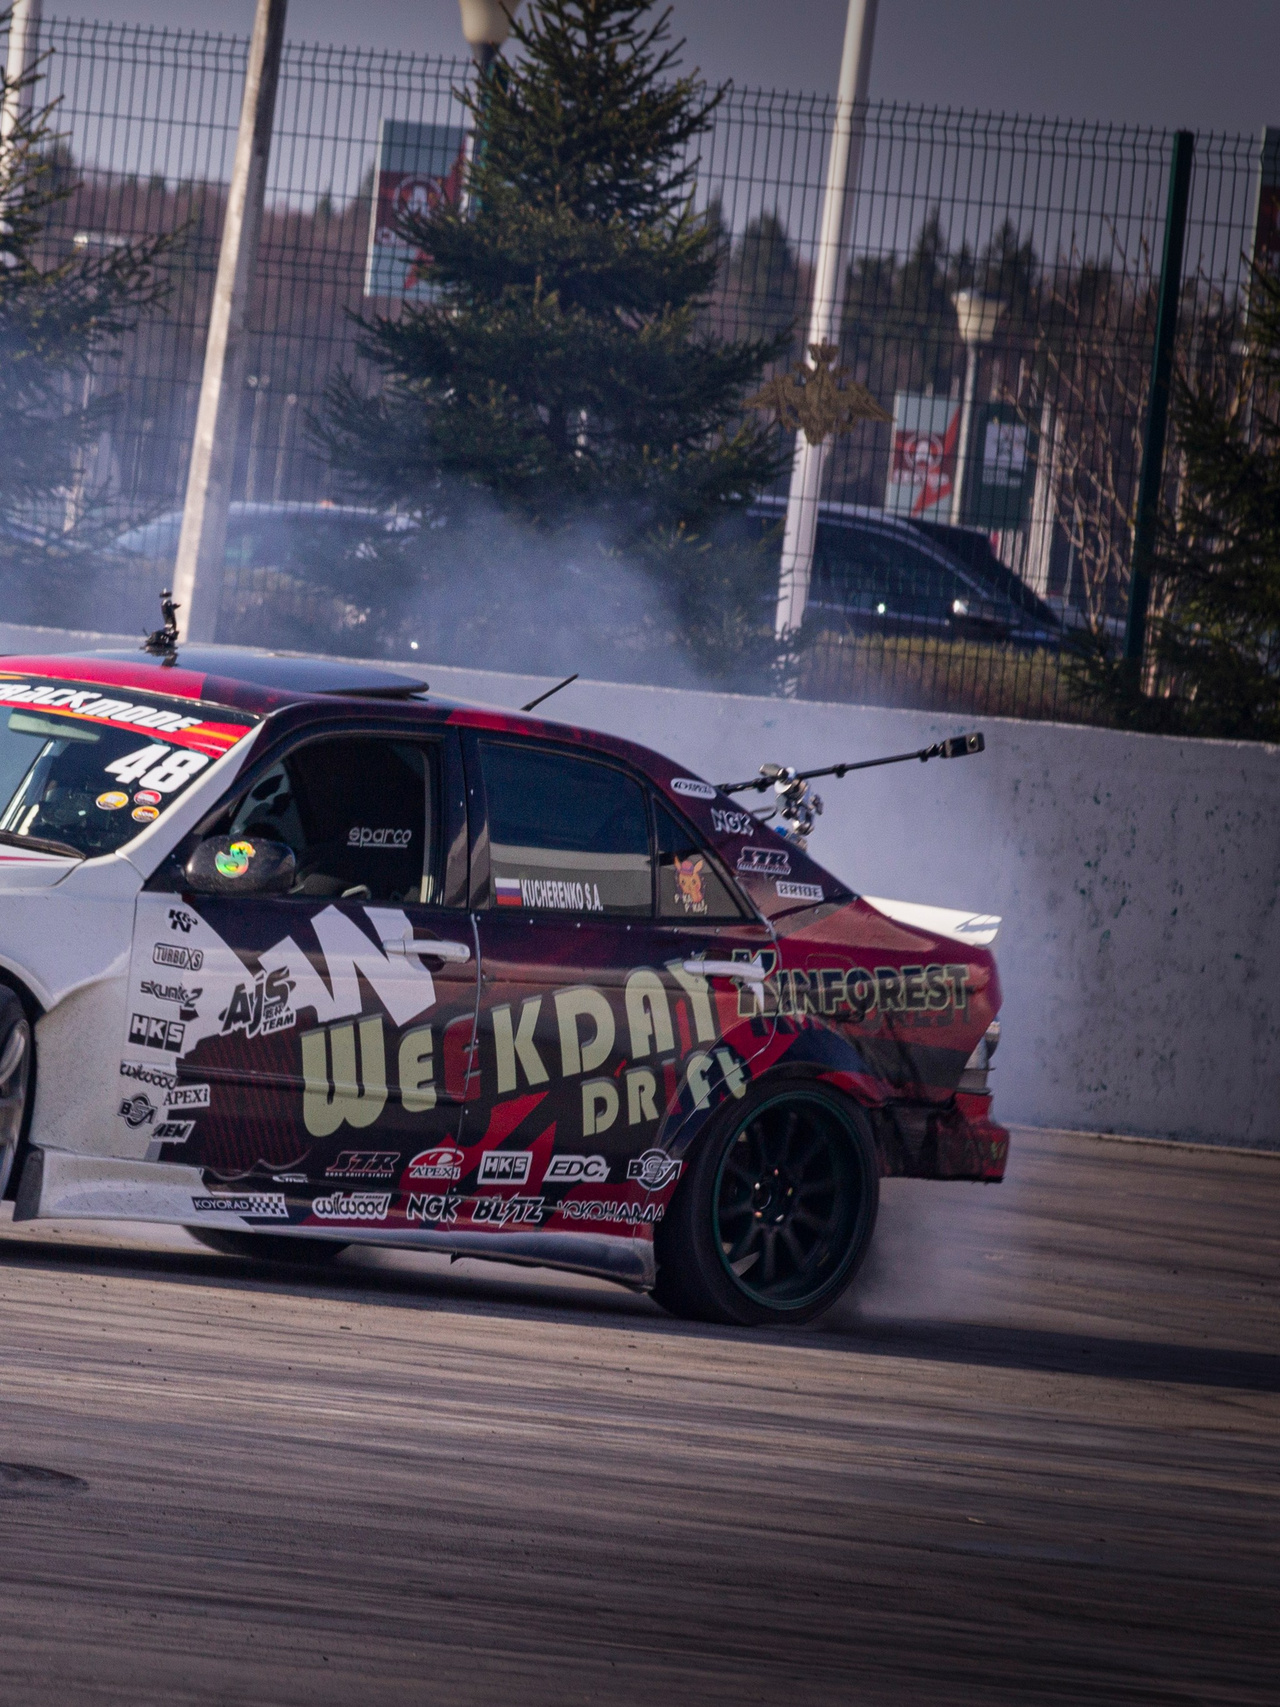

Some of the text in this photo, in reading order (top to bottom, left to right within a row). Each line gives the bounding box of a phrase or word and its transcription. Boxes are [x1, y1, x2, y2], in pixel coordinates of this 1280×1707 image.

[104, 743, 209, 793] 48
[710, 807, 754, 837] NGK
[347, 827, 412, 848] sparco
[521, 879, 604, 912] KUCHERENKO S.A.
[779, 883, 821, 899] BRIDE
[130, 1014, 185, 1050] HKS
[262, 1012, 294, 1032] TEAM
[151, 1122, 192, 1138] AEM
[326, 1151, 401, 1172] STR
[482, 1156, 528, 1178] HKS
[195, 1200, 250, 1210] KOYORAD
[316, 1194, 391, 1216] wilwood
[408, 1194, 461, 1223] NGK
[472, 1194, 545, 1226] BLITZ
[557, 1201, 665, 1224] YOKOHAMA
